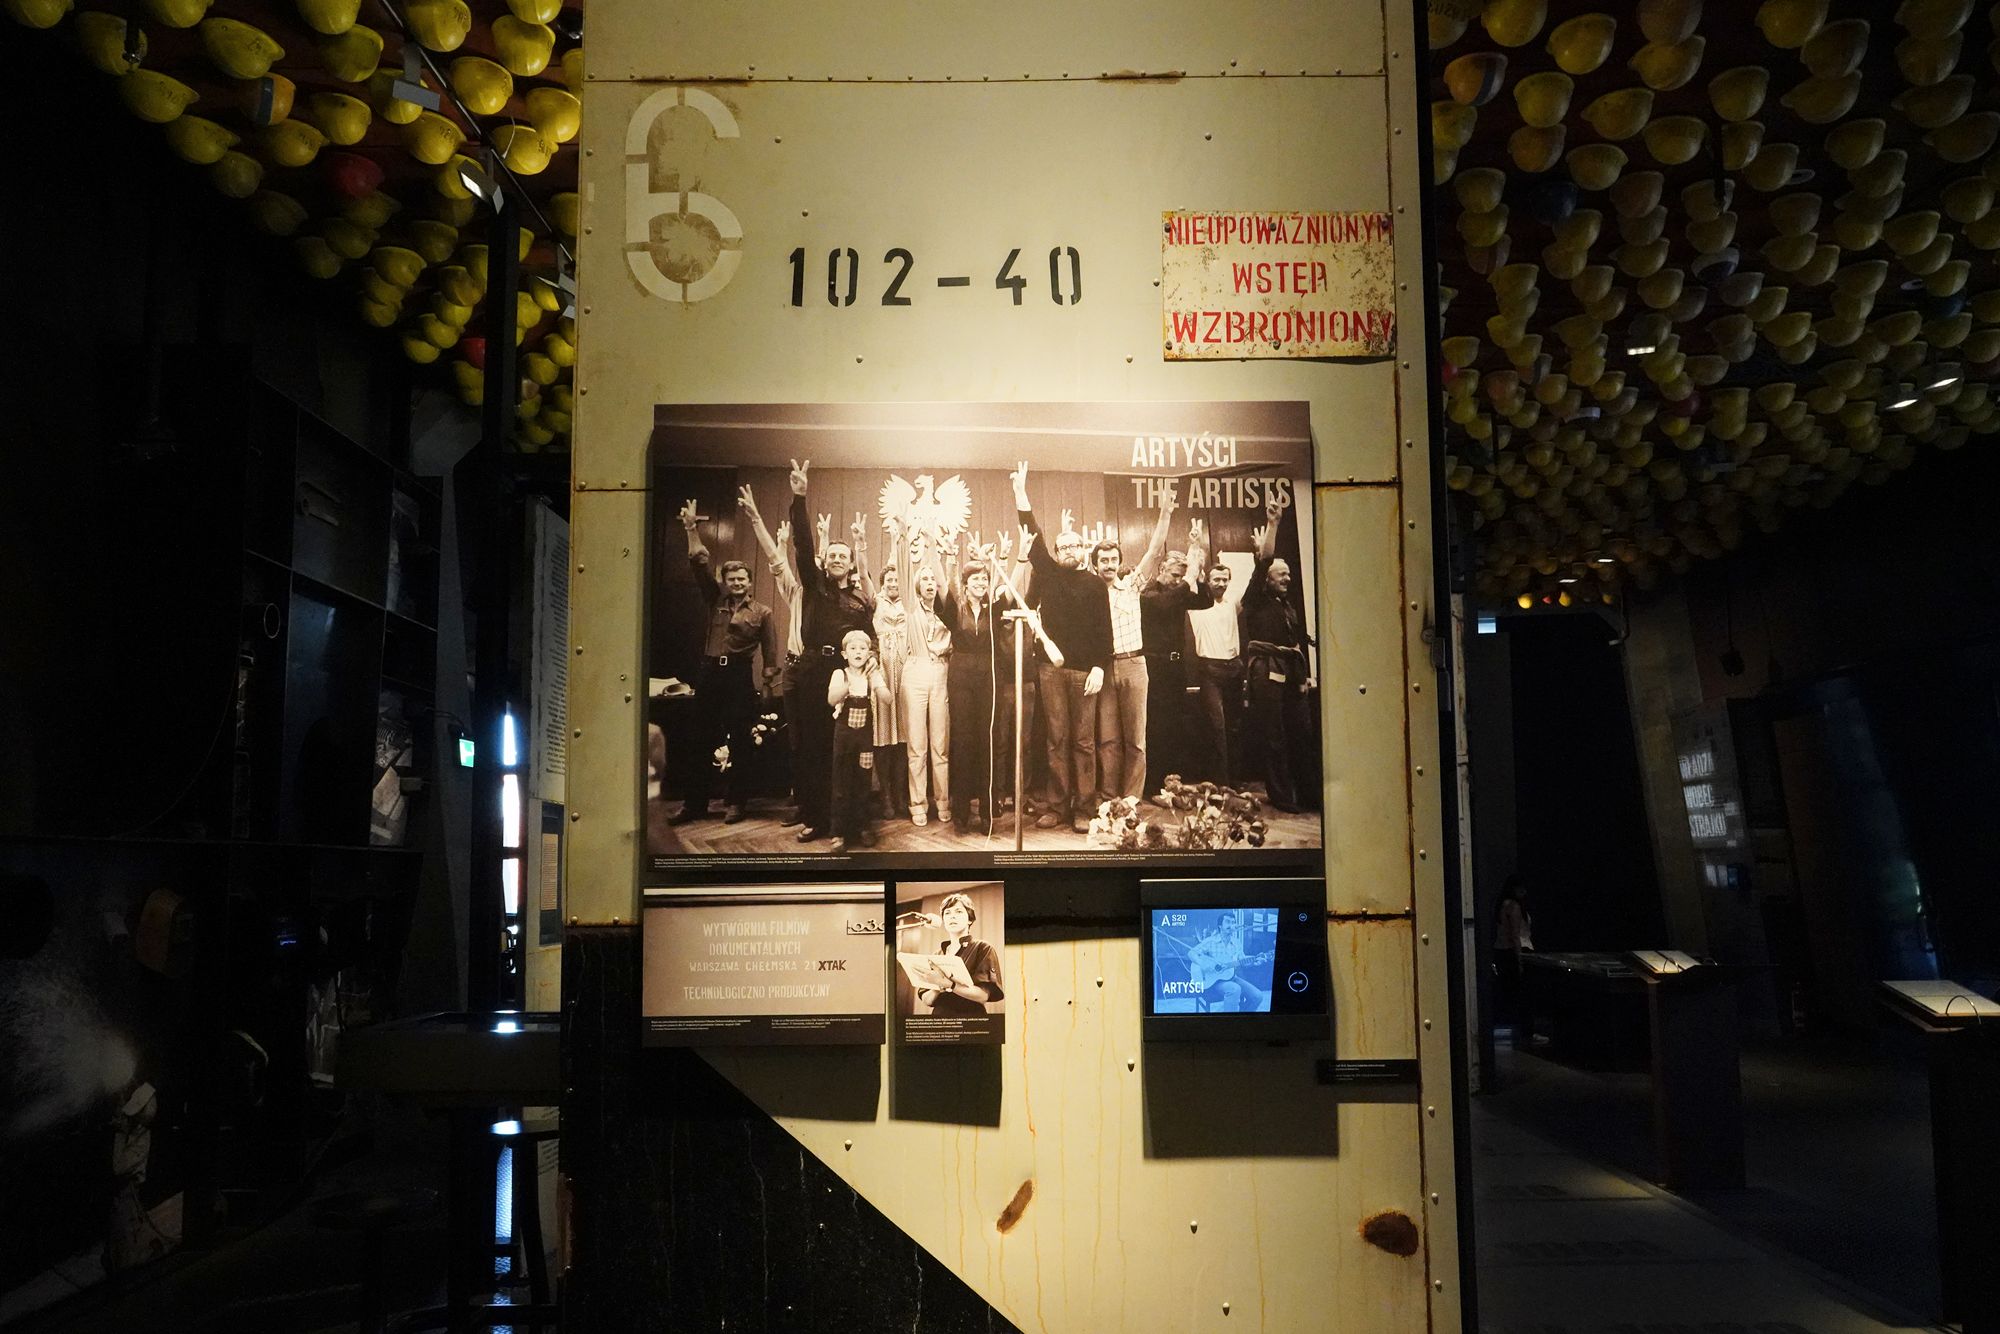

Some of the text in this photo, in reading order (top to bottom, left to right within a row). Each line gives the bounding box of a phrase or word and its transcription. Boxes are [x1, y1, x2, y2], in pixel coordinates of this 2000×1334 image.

[625, 86, 743, 302] 6
[1232, 261, 1328, 298] WSTĘP
[1172, 310, 1394, 344] WZBRONIONY
[1131, 431, 1237, 467] ARTYŚCI
[1131, 477, 1291, 509] THE ARTISTS
[1171, 914, 1187, 922] S20
[709, 940, 801, 956] DOKUMENTALNYCH
[689, 960, 740, 972] WARSZAWA
[683, 984, 831, 1000] TECHNOLOGICZNO PRODUKCYJNY
[1163, 978, 1204, 994] ARTYŚCI
